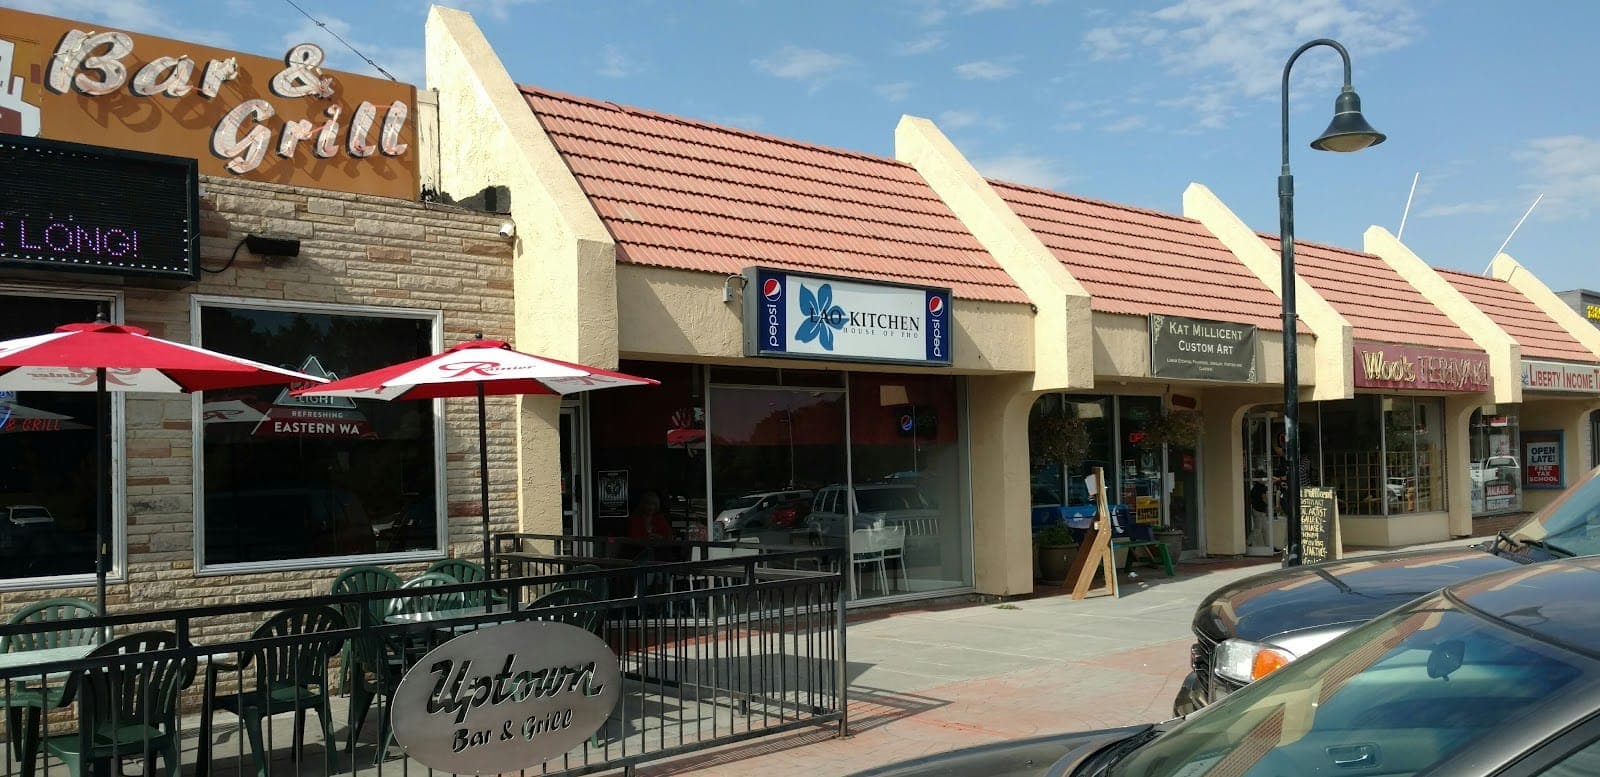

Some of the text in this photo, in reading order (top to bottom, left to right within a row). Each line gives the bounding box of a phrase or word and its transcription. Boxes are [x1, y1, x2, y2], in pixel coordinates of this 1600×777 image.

[47, 28, 334, 98] Bar &
[210, 99, 408, 174] Grill
[20, 219, 138, 259] LONG!
[767, 303, 780, 347] pepsi
[809, 308, 920, 332] LAO KITCHEN
[843, 327, 875, 336] HOUSE
[931, 318, 942, 357] pepsi
[22, 416, 60, 432] GRILL
[274, 421, 360, 435] EASTERN WA
[291, 410, 344, 419] REFRESHING
[1531, 446, 1556, 455] OPEN
[1531, 455, 1556, 463] LATE!
[426, 653, 605, 725] Uptown
[452, 708, 574, 753] Bar & Grill
